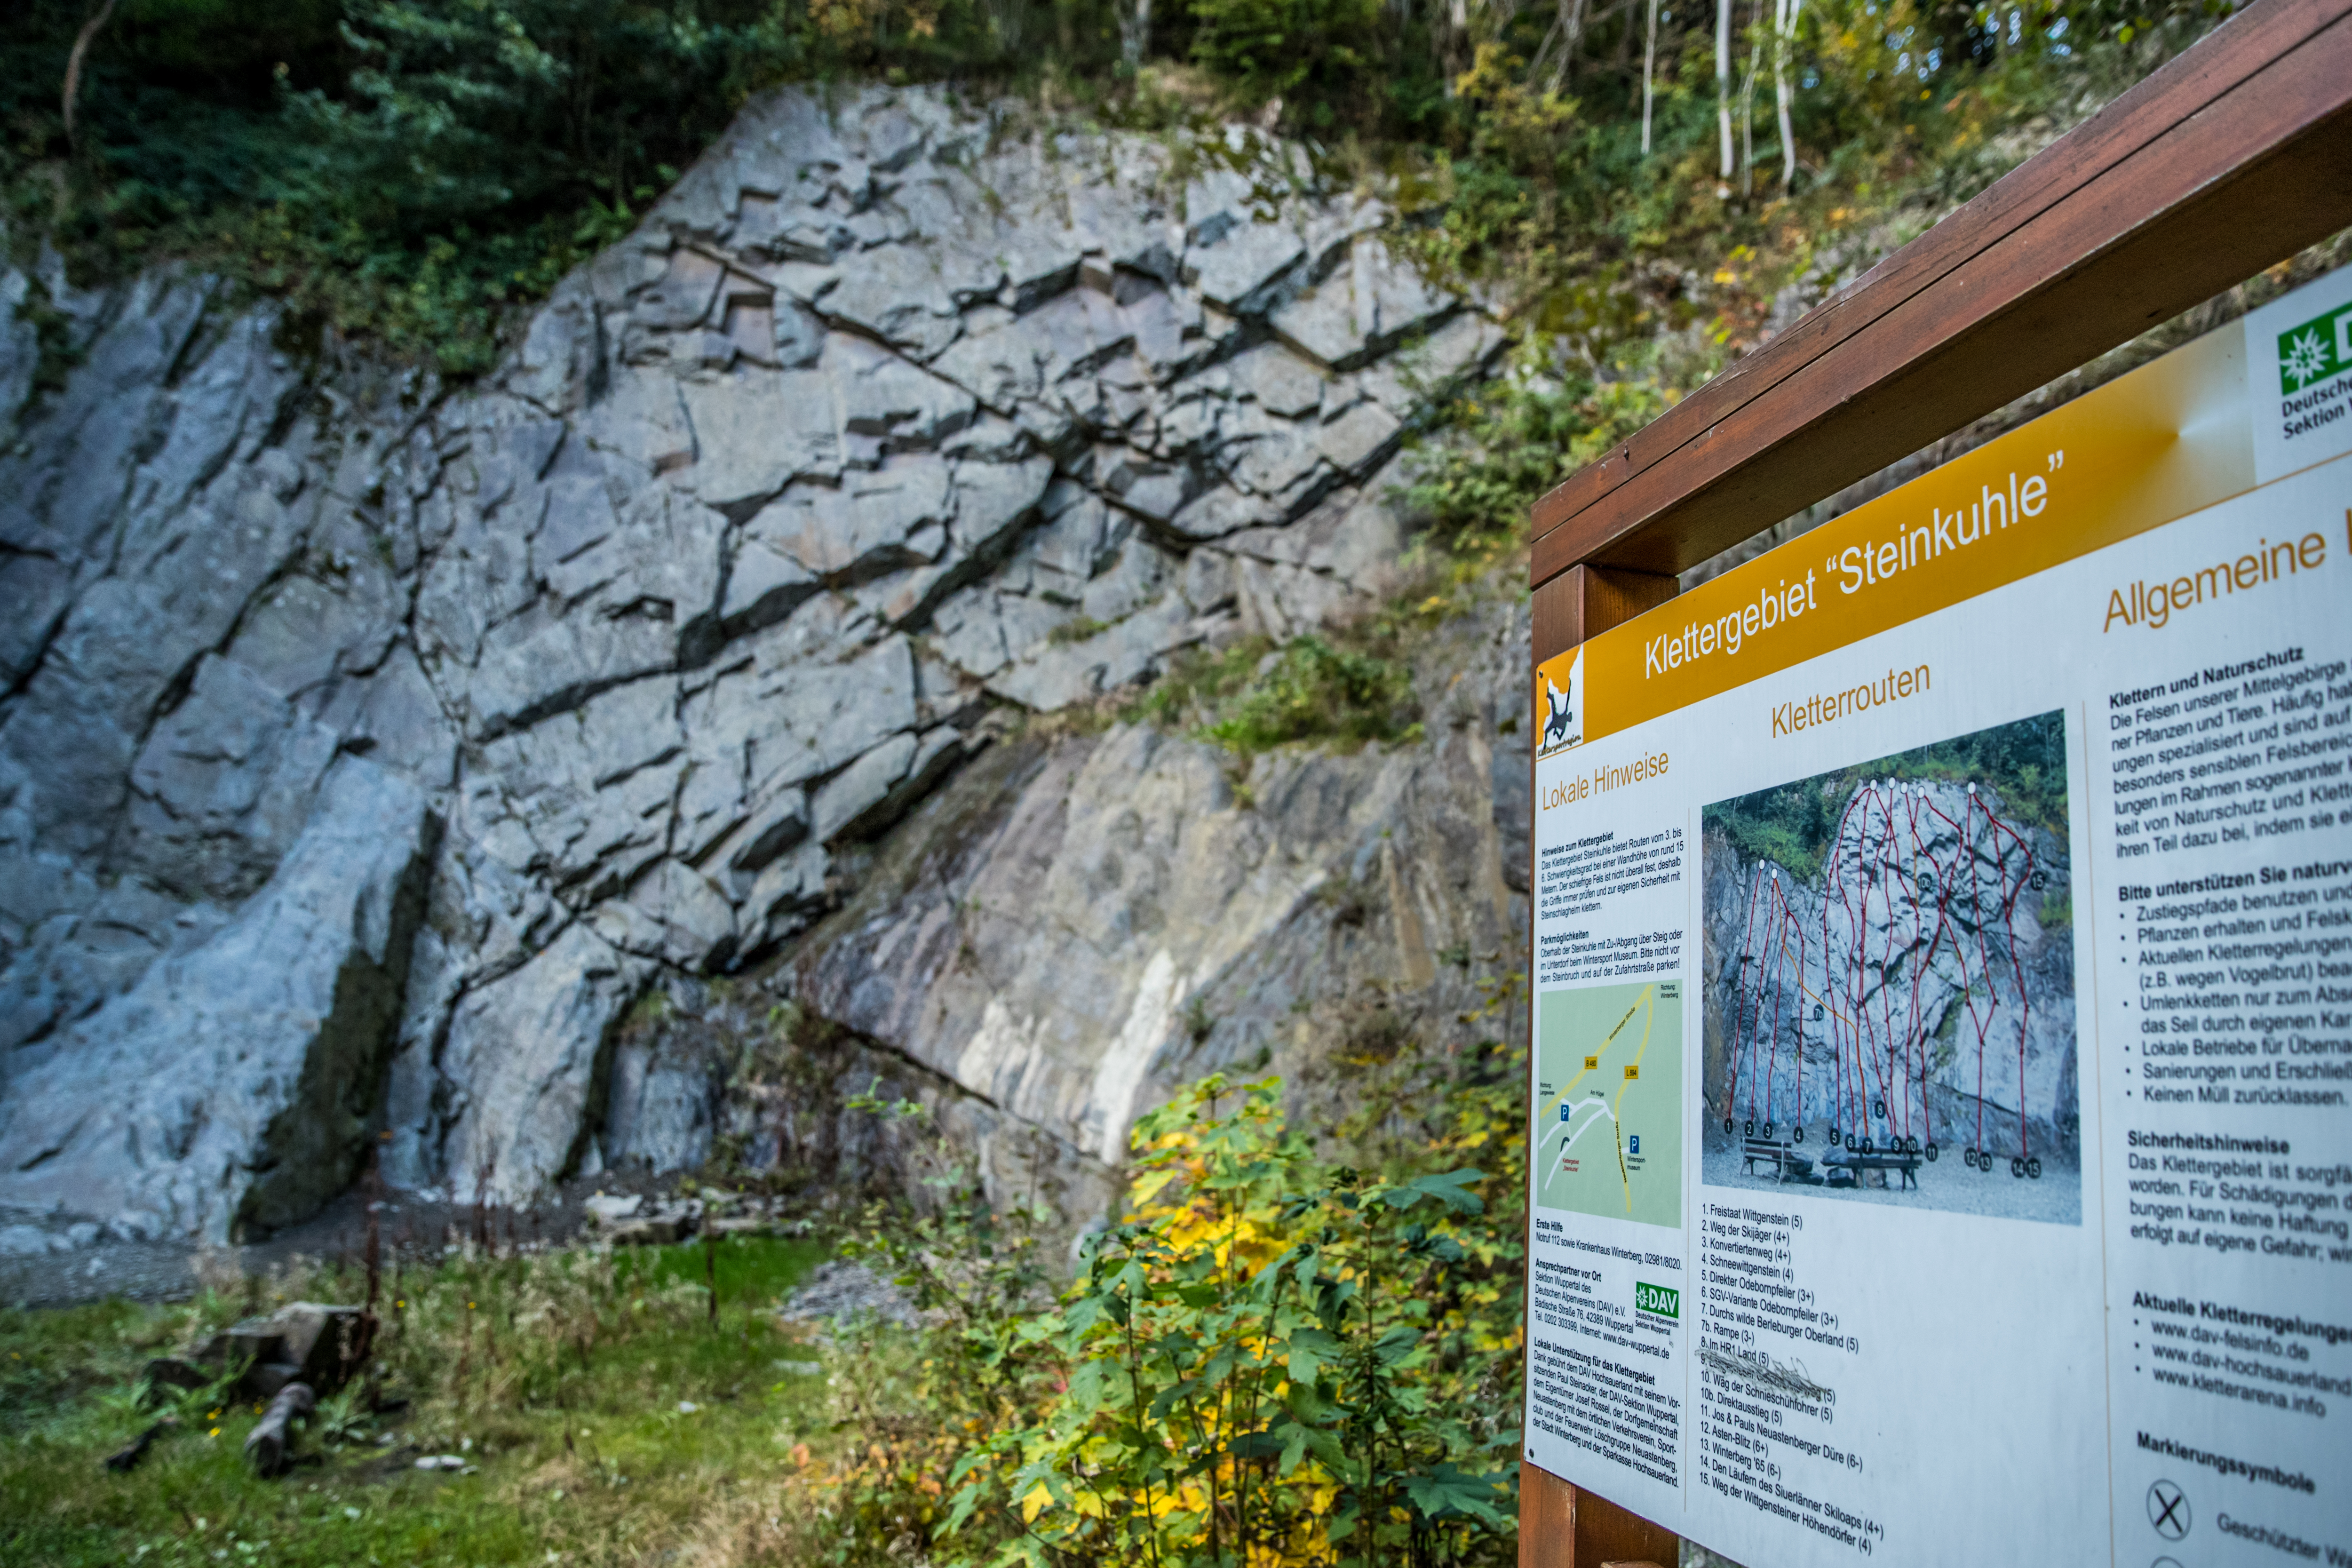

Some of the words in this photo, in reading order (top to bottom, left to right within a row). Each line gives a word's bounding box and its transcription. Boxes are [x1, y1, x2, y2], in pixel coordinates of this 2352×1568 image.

[2284, 404, 2344, 439] Sektion
[1645, 568, 1816, 679] Klettergebiet
[1826, 450, 2064, 595] “Steinkuhle”
[2104, 532, 2326, 633] Allgemeine
[2109, 685, 2166, 709] Klettern
[2169, 672, 2199, 694] und
[2203, 646, 2304, 685] Naturschutz
[2110, 714, 2132, 731] Die
[2136, 703, 2180, 724] Felsen
[2184, 688, 2240, 713] unserer
[2243, 661, 2347, 698] Mittelgebirge
[1772, 664, 1930, 738] Kletterrouten
[1542, 773, 1589, 811] Lokale
[1595, 751, 1669, 794] Hinweise
[1542, 844, 1565, 858] Hinweise
[1565, 842, 1577, 852] zum
[1578, 831, 1613, 849] Klettergebiet
[1542, 860, 1551, 870] Das
[1552, 852, 1583, 868] Klettergebiet
[1583, 845, 1611, 860] Steinkuhle
[1612, 841, 1628, 853] bietet
[1629, 836, 1650, 849] Routen
[1651, 833, 1664, 844] vom
[1665, 830, 1671, 840] 3.
[1672, 828, 1682, 838] bis
[2118, 884, 2152, 902] Bitte
[2156, 872, 2255, 897] unterstützen
[2259, 868, 2288, 884] Sie
[1541, 930, 1589, 945] Parkmöglichkeiten
[2128, 1131, 2290, 1154] Sicherheitshinweise
[1536, 1218, 1550, 1230] Erste
[1550, 1221, 1563, 1233] Hilfe
[1702, 1203, 1708, 1215] 1.
[1710, 1204, 1741, 1219] Freistaat
[1742, 1208, 1789, 1226] Wittgenstein
[1791, 1214, 1803, 1231] (5)
[1710, 1220, 1726, 1237] Weg
[1727, 1223, 1740, 1236] der
[1741, 1225, 1772, 1243] Skijäger
[1773, 1230, 1790, 1247] (4+)
[1536, 1231, 1551, 1243] Notruf
[1551, 1234, 1560, 1246] 112
[1561, 1238, 1575, 1249] sowie
[1576, 1239, 1611, 1256] Krankenhaus
[1611, 1246, 1644, 1265] Winterberg,
[1701, 1236, 1708, 1248] 3.
[1710, 1237, 1773, 1262] Konvertiertenweg
[1775, 1248, 1791, 1265] (4+)
[1535, 1258, 1580, 1277] Ansprechpartner
[1581, 1270, 1591, 1280] vor
[1591, 1271, 1602, 1282] Ort
[1701, 1253, 1708, 1265] 4.
[1710, 1254, 1780, 1279] Schneewittgenstein
[1782, 1267, 1794, 1284] (4)
[1535, 1284, 1561, 1300] Deutschen
[1561, 1291, 1596, 1309] Alpenvereins
[1597, 1299, 1614, 1316] (DAV)
[1614, 1305, 1626, 1317] e.V.
[1649, 1288, 1677, 1314] DAV
[1701, 1269, 1708, 1281] 5.
[1709, 1271, 1738, 1287] Direkter
[1739, 1277, 1796, 1299] Odebornpfeiler
[1797, 1288, 1814, 1306] (3+)
[2132, 1292, 2196, 1316] Aktuelle
[1534, 1297, 1557, 1313] Badische
[1558, 1304, 1576, 1318] Straße
[1576, 1308, 1585, 1321] 76,
[1586, 1311, 1604, 1325] 42389
[1604, 1316, 1634, 1334] Wuppertal
[1635, 1310, 1655, 1322] Deutscher
[1655, 1315, 1679, 1329] Alpenverein
[1701, 1286, 1708, 1298] 6.
[1709, 1288, 1758, 1310] SGV-Variante
[1760, 1298, 1819, 1323] Odebornpfeiler
[1820, 1312, 1838, 1330] (3+)
[1535, 1310, 1543, 1321] Tel.
[1544, 1313, 1557, 1326] 0202
[1580, 1323, 1602, 1339] Internet:
[1603, 1332, 1669, 1360] www.dav-wuppertal.de
[1635, 1320, 1650, 1330] Sektion
[1650, 1323, 1671, 1336] Wuppertal
[1701, 1302, 1708, 1315] 7.
[1709, 1304, 1734, 1321] Durchs
[1736, 1312, 1755, 1326] wilde
[1757, 1315, 1803, 1339] Berleburger
[1804, 1327, 1844, 1348] Oberland
[1846, 1337, 1859, 1355] (5)
[1701, 1319, 1712, 1333] 7b.
[1714, 1322, 1740, 1341] Rampe
[1741, 1329, 1755, 1346] (3-)
[1534, 1337, 1551, 1351] Lokale
[1552, 1342, 1591, 1367] Unterstützung
[1592, 1355, 1601, 1368] für
[1602, 1359, 1613, 1372] das
[1614, 1362, 1655, 1386] Klettergebiet
[1701, 1336, 1707, 1348] 8.
[1709, 1338, 1718, 1351] Im
[1720, 1340, 1735, 1356] HR1
[1738, 1345, 1756, 1362] Land
[1758, 1351, 1769, 1368] (5)
[1700, 1386, 1715, 1402] 10b.
[1717, 1391, 1769, 1421] Direktausstieg
[1771, 1409, 1782, 1425] (5)
[1701, 1370, 1711, 1384] 10.
[1713, 1373, 1730, 1392] Wäg
[1731, 1379, 1744, 1393] der
[1820, 1406, 1833, 1424] (5)
[1700, 1403, 1710, 1417] 11.
[1712, 1408, 1725, 1423] Jos
[1726, 1414, 1732, 1425] &
[1734, 1414, 1755, 1433] Pauls
[1756, 1422, 1821, 1456] Neuastenberger
[1823, 1444, 1844, 1464] Düre
[1846, 1453, 1863, 1473] (6-)
[1700, 1420, 1711, 1435] 12.
[1712, 1425, 1751, 1449] Asten-Blitz
[1752, 1439, 1769, 1458] (6+)
[1700, 1437, 1710, 1452] 13.
[1712, 1441, 1752, 1470] Winterberg
[1767, 1462, 1781, 1480] (6-)
[2137, 1433, 2316, 1496] Markierungssymbole
[1700, 1454, 1710, 1469] 14.
[1712, 1458, 1727, 1476] Den
[1729, 1465, 1757, 1488] Läufern
[1758, 1478, 1773, 1494] des
[1775, 1483, 1822, 1513] Siuerlänner
[1824, 1503, 1862, 1530] Skiloaps
[1864, 1518, 1884, 1541] (4+)
[1700, 1471, 1710, 1486] 15.
[1712, 1476, 1728, 1496] Weg
[1730, 1484, 1743, 1499] der
[1744, 1488, 1800, 1523] Wittgensteiner
[1802, 1512, 1857, 1546] Höhendörfer
[1858, 1536, 1872, 1555] (4)
